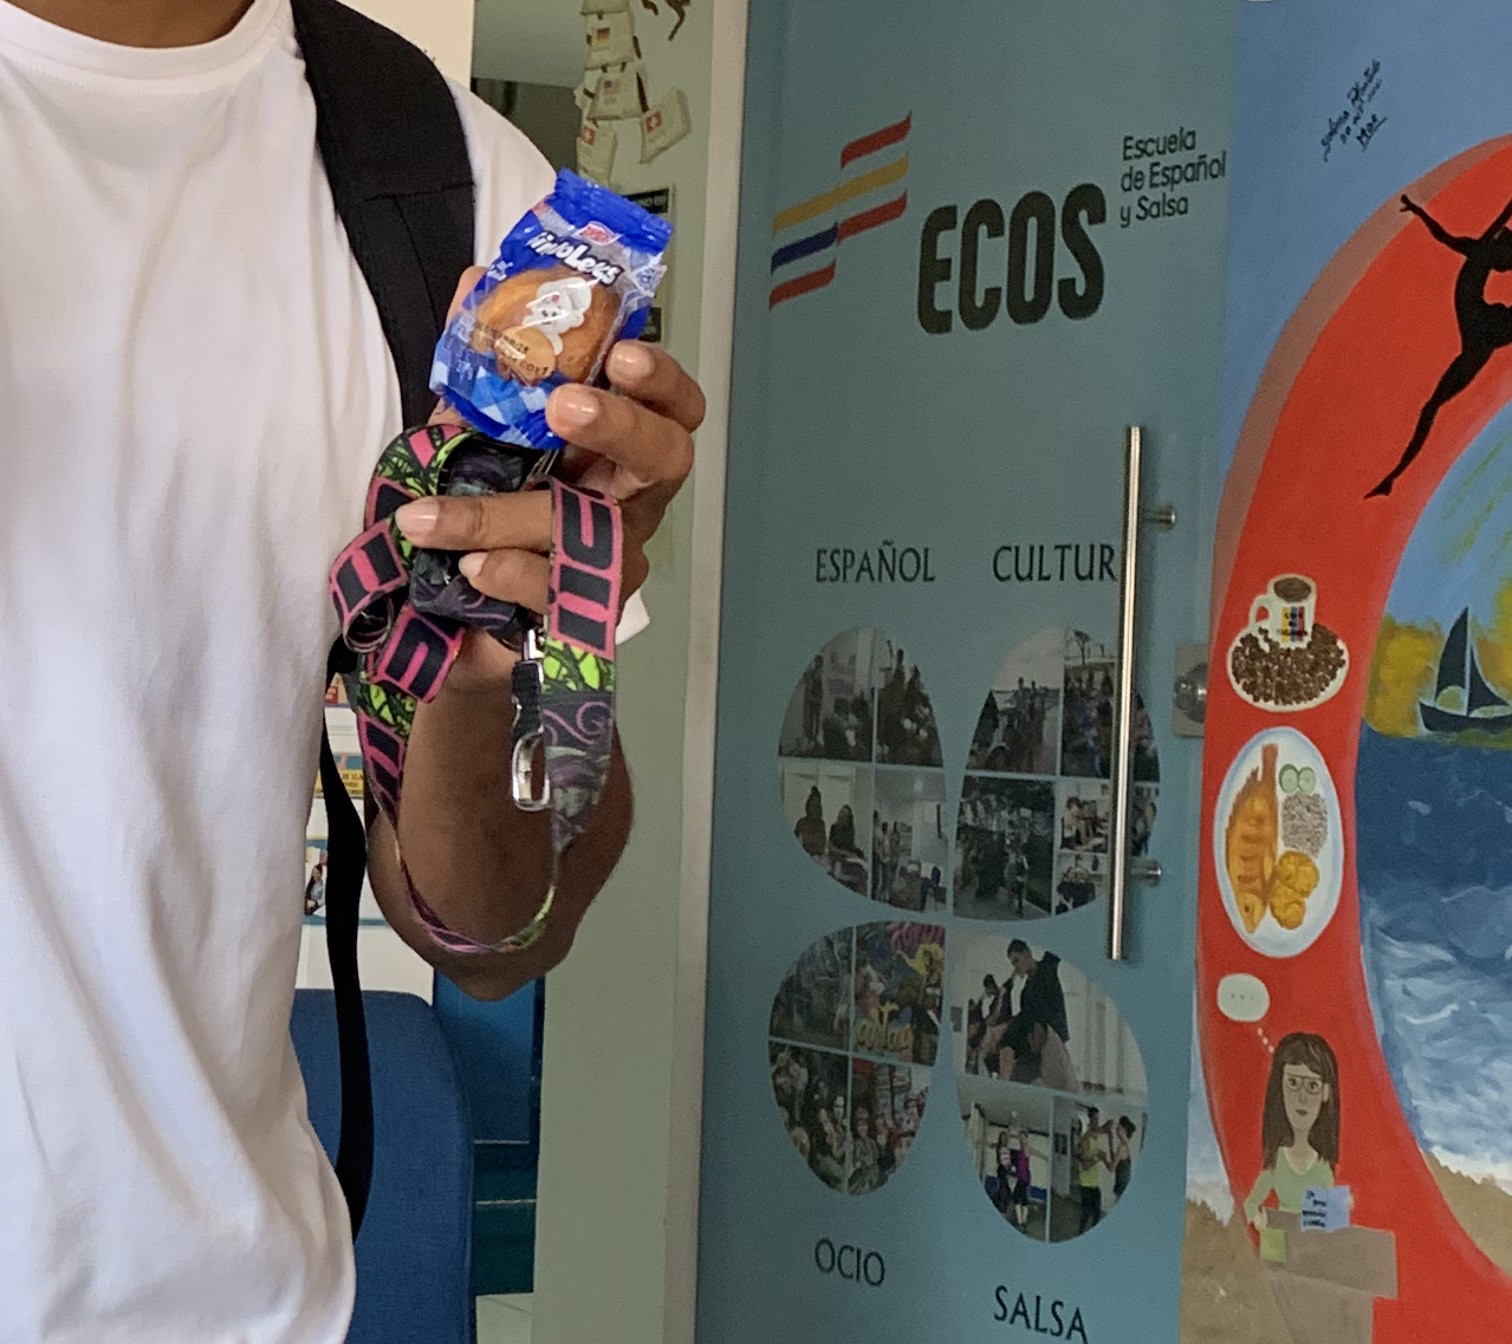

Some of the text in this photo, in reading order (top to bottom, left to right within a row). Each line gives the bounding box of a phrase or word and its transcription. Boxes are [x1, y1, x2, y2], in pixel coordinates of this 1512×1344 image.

[1122, 126, 1196, 161] Escuela
[1120, 149, 1226, 192] de Español
[1120, 192, 1188, 229] y Salsa
[917, 182, 1107, 335] ECOS
[815, 540, 936, 583] ESPAÑOL
[993, 542, 1120, 582] CULTUR
[814, 1237, 886, 1287] OCIO
